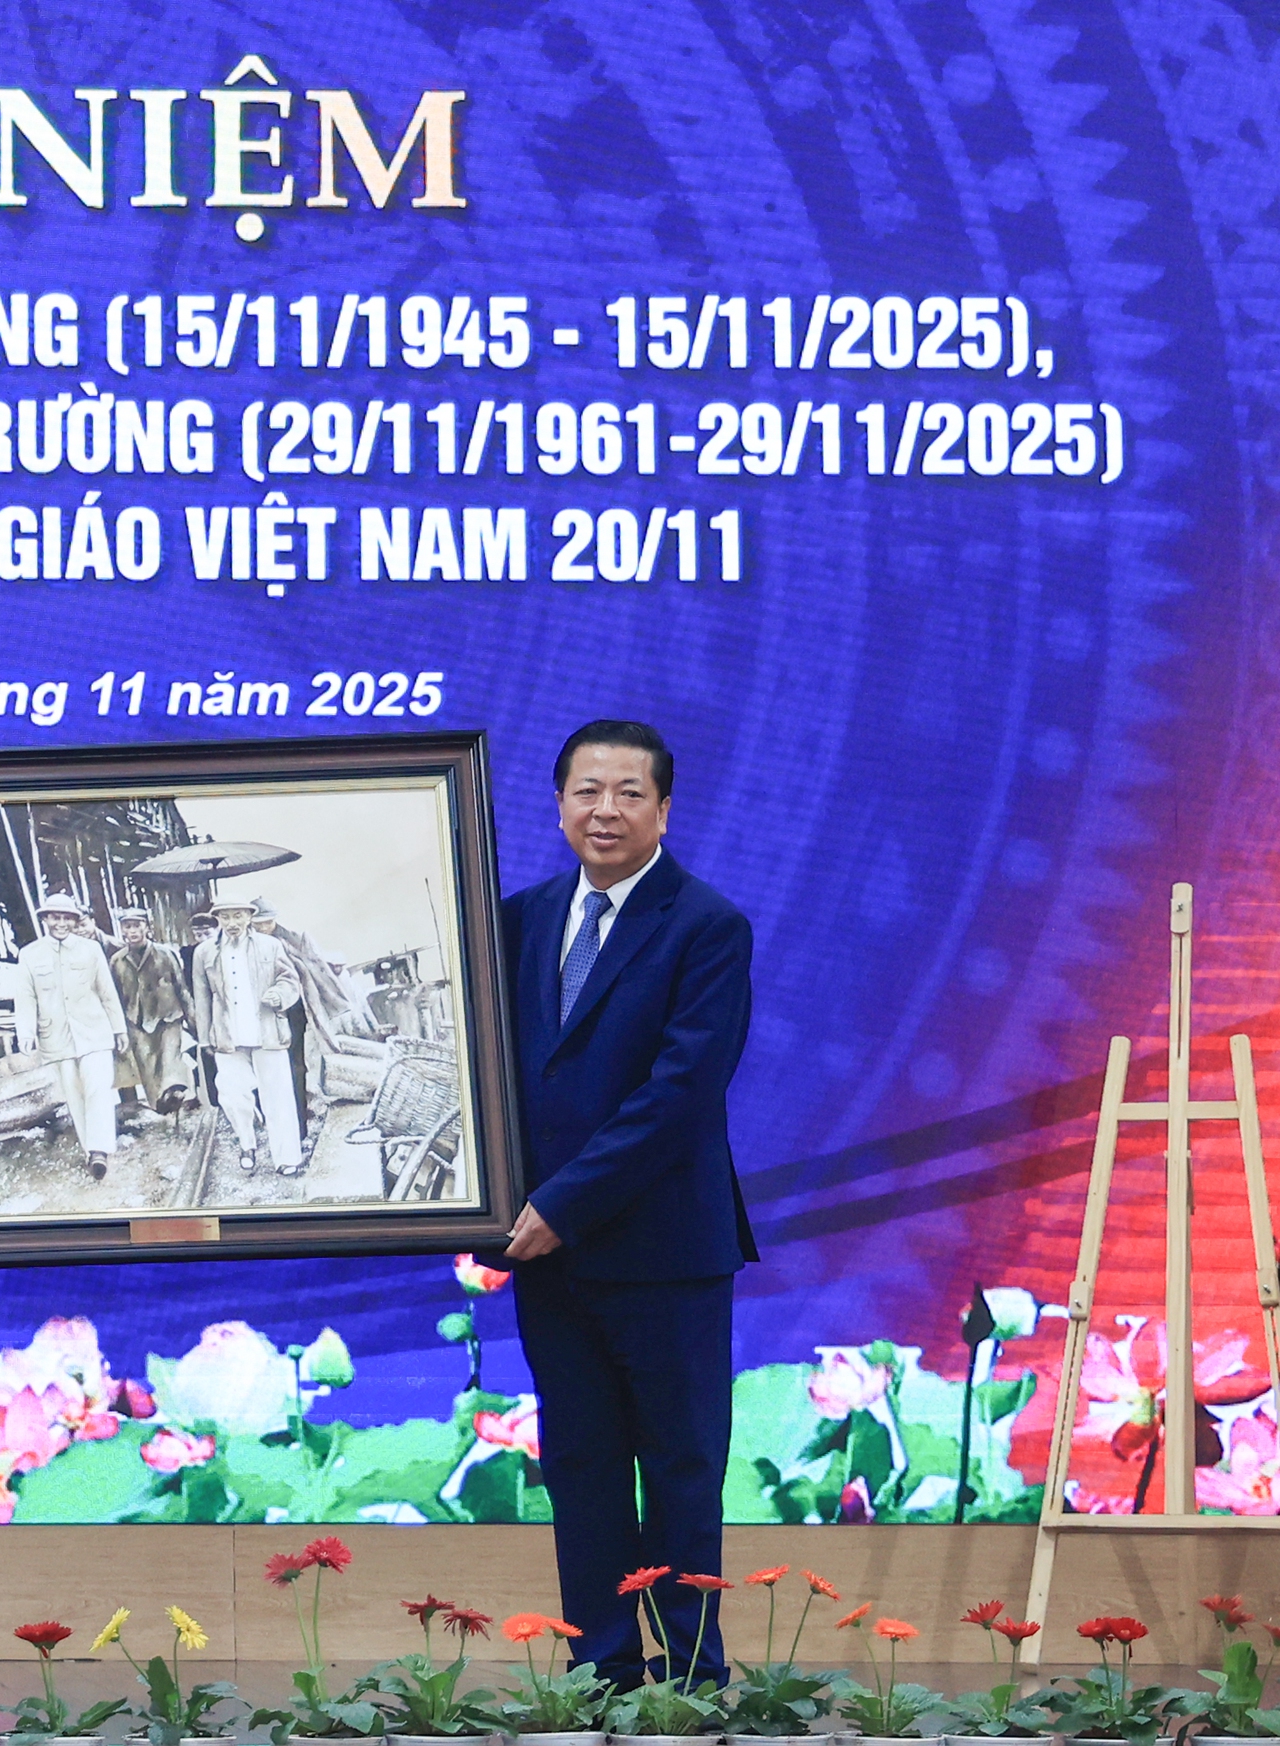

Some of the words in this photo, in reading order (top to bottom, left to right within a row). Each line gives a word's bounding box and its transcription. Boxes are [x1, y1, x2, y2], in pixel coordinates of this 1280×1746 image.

[106, 292, 531, 376] (15/11/1945
[553, 328, 580, 345] -
[605, 294, 1054, 378] 15/11/2025),
[241, 399, 1124, 484] (29/11/1961-29/11/2025)
[184, 491, 337, 597] VIỆT
[359, 506, 527, 581] NAM
[551, 507, 740, 582] 20/11
[90, 671, 146, 716] 11
[166, 671, 290, 716] năm
[305, 671, 444, 717] 2025
